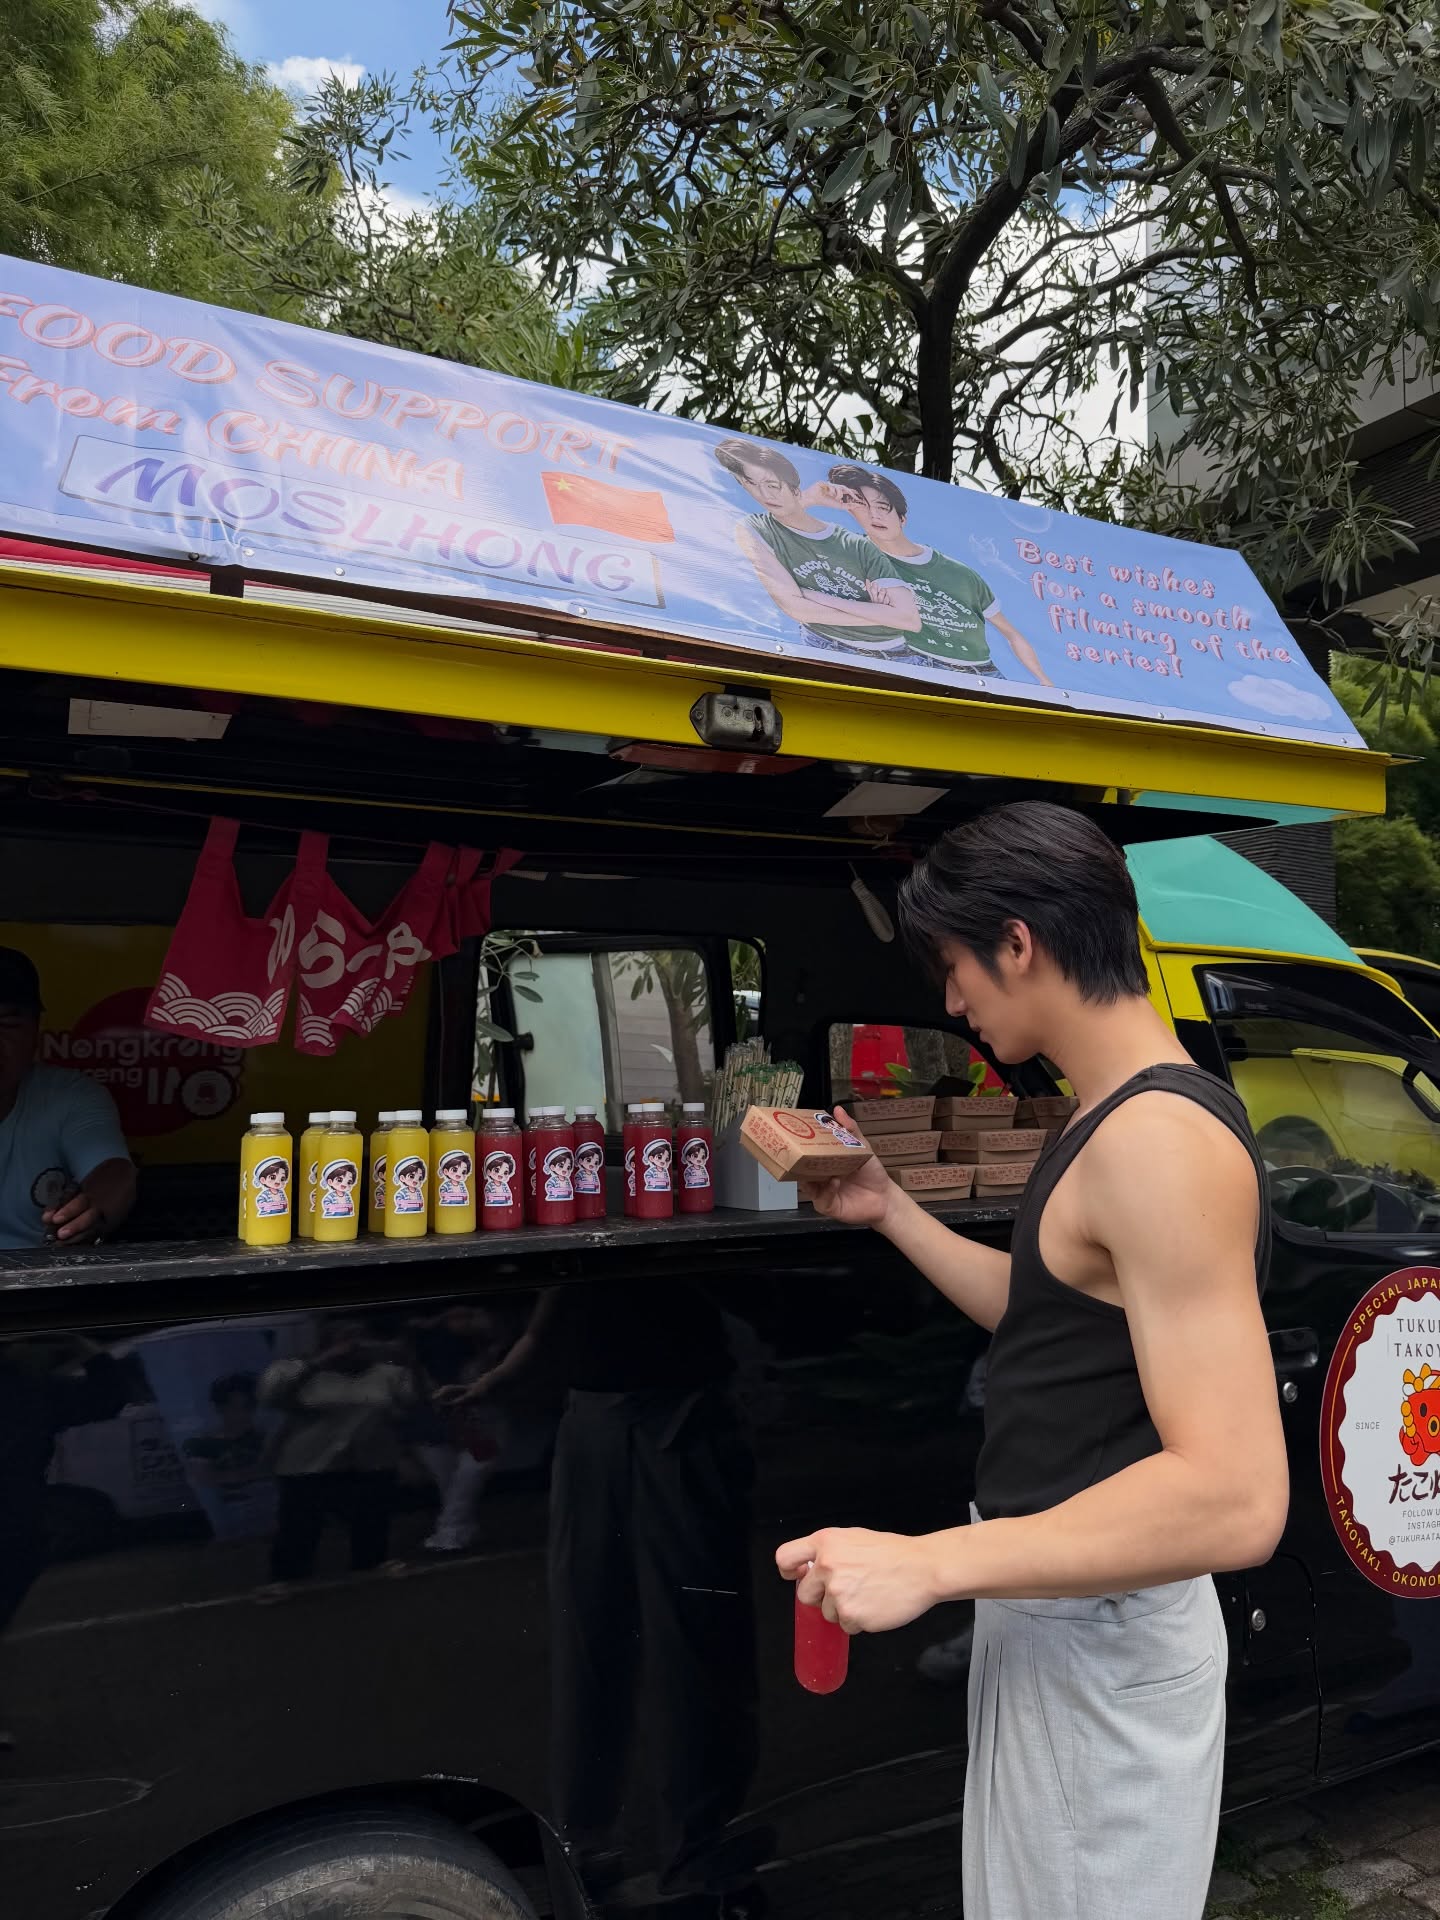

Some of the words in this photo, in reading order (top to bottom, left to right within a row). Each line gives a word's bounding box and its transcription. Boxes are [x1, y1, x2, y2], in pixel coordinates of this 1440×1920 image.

[256, 359, 635, 472] SUPPORT
[206, 409, 465, 501] CHINA
[94, 458, 635, 592] MOSLHONG
[1013, 538, 1096, 577] Best
[1108, 564, 1216, 599] wishes
[1030, 571, 1085, 600] for
[1099, 592, 1118, 609] a
[1132, 597, 1250, 631] smooth
[1048, 603, 1177, 655] filming
[1190, 634, 1224, 661] of
[1235, 637, 1292, 663] the
[1066, 642, 1183, 678] series!
[1353, 1283, 1403, 1334] SPECIAL
[1407, 1277, 1440, 1290] JAPA
[1396, 1318, 1440, 1333] TUKU
[1355, 1421, 1380, 1430] SINCE
[1336, 1495, 1381, 1572] TAKOYAKI
[1392, 1571, 1440, 1587] OKONO
[1402, 1509, 1433, 1518] FOLLOW
